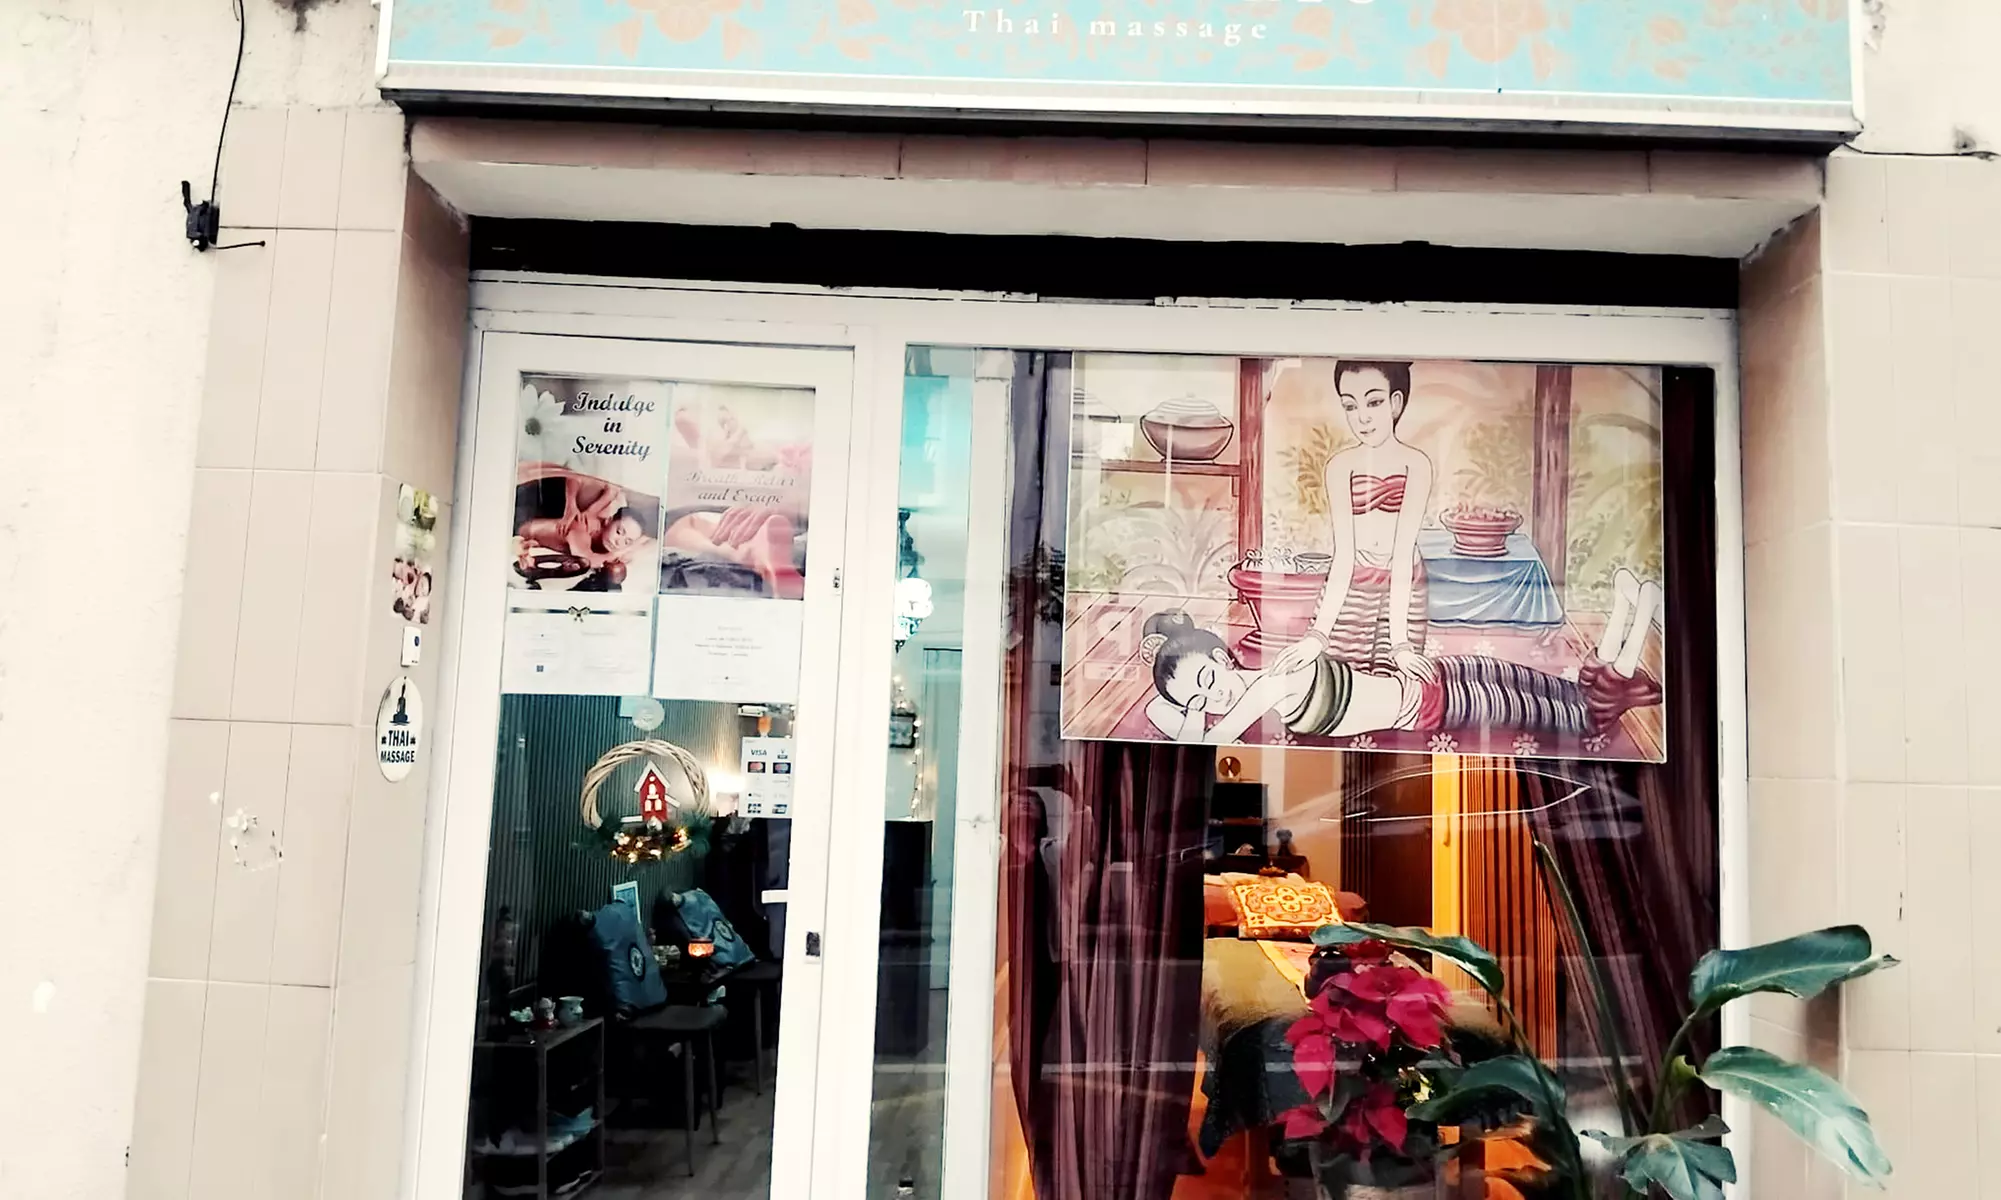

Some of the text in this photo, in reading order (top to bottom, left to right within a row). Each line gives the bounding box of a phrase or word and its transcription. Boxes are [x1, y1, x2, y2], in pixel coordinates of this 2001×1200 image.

[962, 10, 1267, 47] Thai massage
[573, 391, 655, 417] Indulge
[603, 417, 622, 433] in
[572, 435, 651, 462] Serenity
[698, 488, 784, 506] and Escape
[388, 730, 409, 747] THAI
[380, 750, 415, 763] MASSAGE
